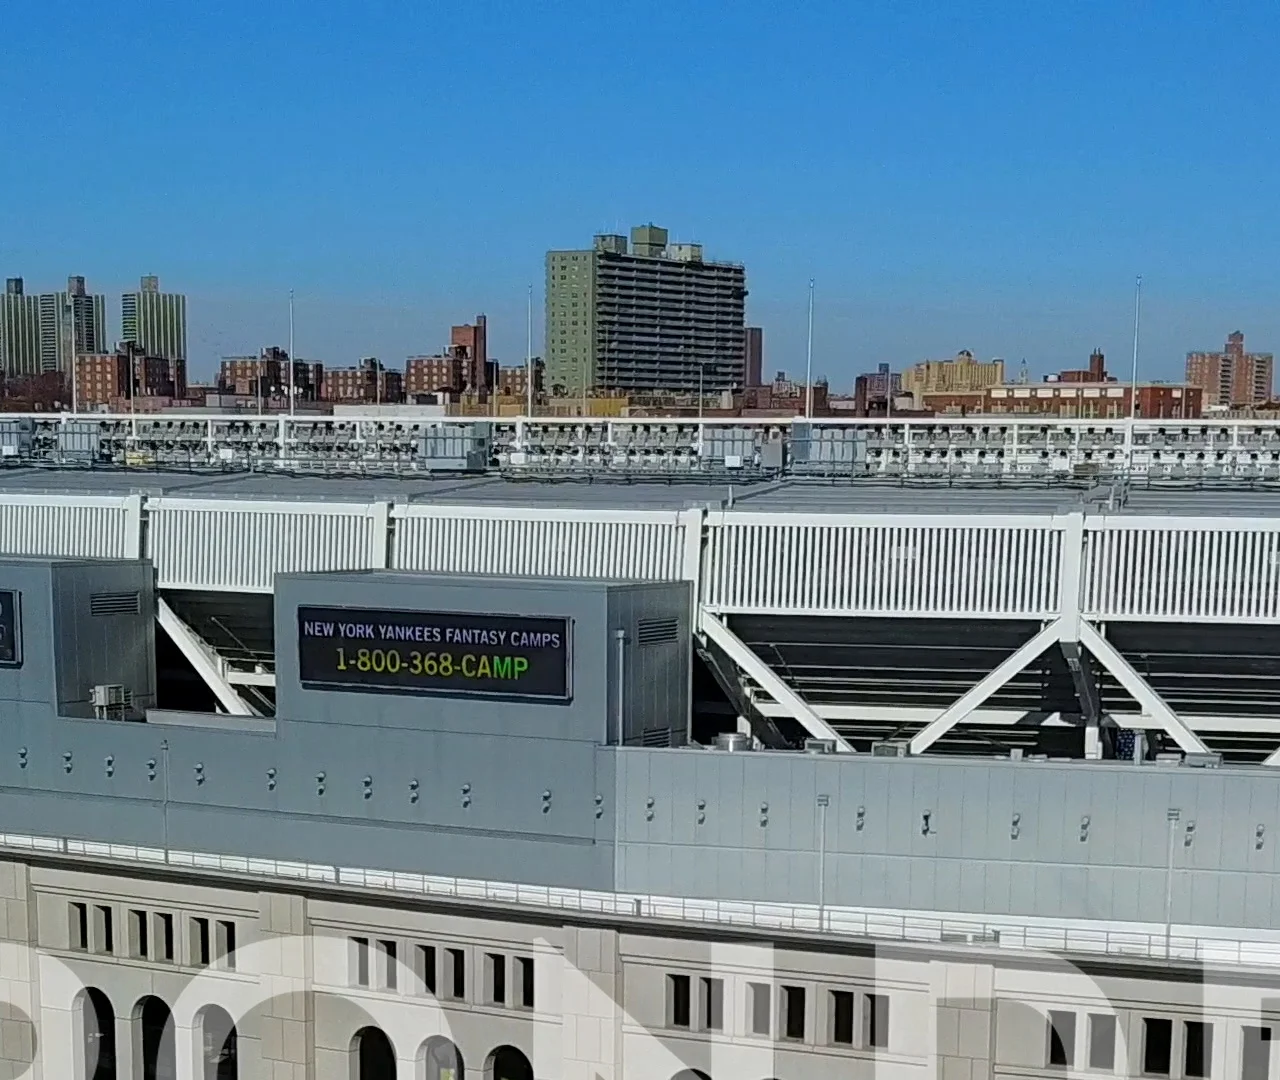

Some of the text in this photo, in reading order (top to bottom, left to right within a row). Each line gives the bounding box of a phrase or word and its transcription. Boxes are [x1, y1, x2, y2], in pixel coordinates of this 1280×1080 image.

[304, 621, 560, 648] NEW YORK YANKEES FANTASY CAMPS
[336, 648, 529, 680] 1-800-368-CAMP
